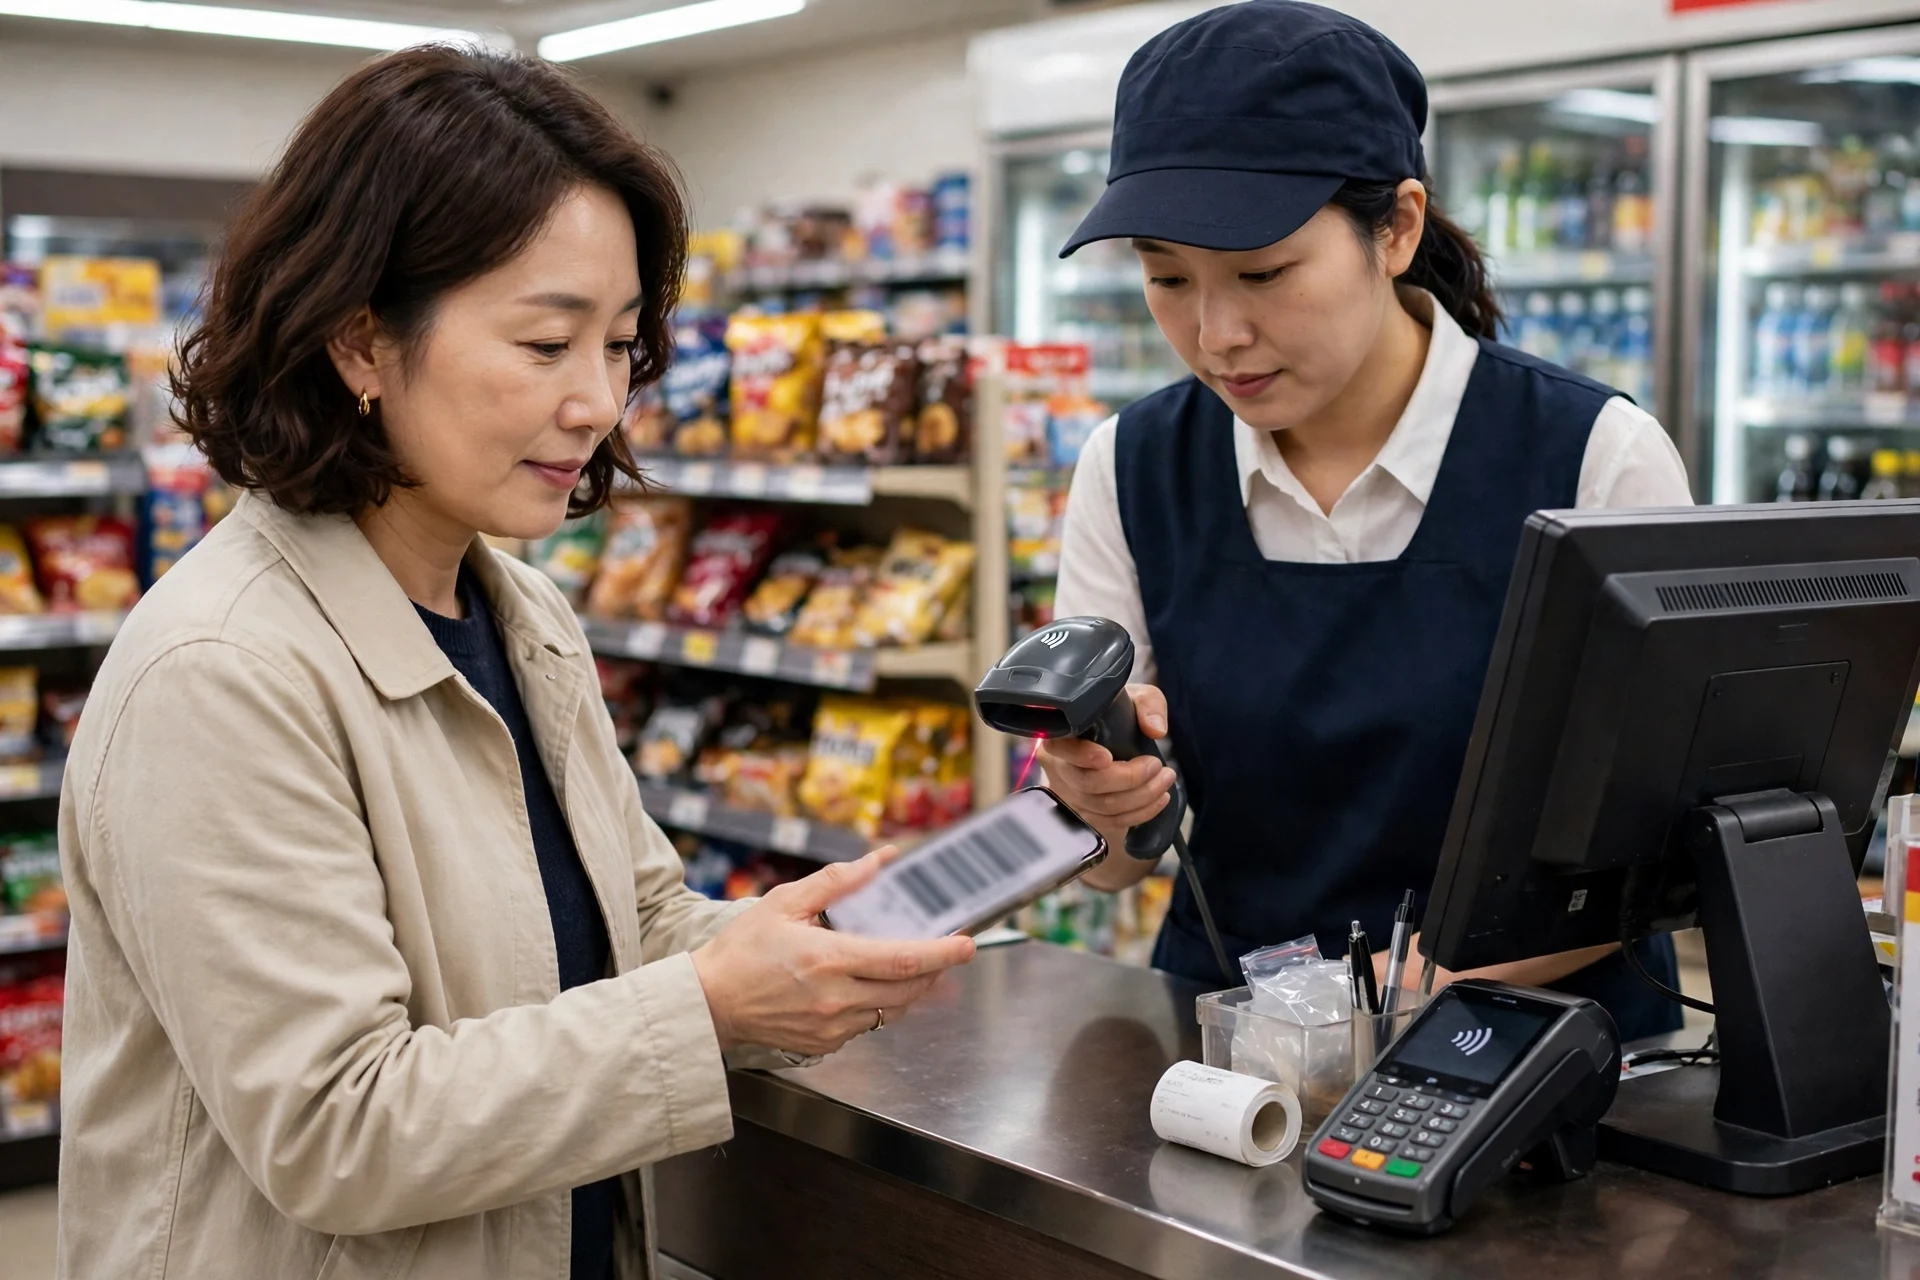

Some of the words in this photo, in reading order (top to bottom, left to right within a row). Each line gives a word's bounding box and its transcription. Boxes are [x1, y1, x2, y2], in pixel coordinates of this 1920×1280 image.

[1375, 1087, 1382, 1095] 1
[1406, 1096, 1417, 1104] 2
[1440, 1103, 1452, 1113] 3
[1360, 1100, 1370, 1109] 4
[1394, 1109, 1405, 1118] 5
[1429, 1117, 1440, 1127] 6
[1349, 1114, 1359, 1122] 7
[1382, 1123, 1394, 1133] 8
[1417, 1132, 1428, 1141] 9
[1370, 1136, 1382, 1146] 0
